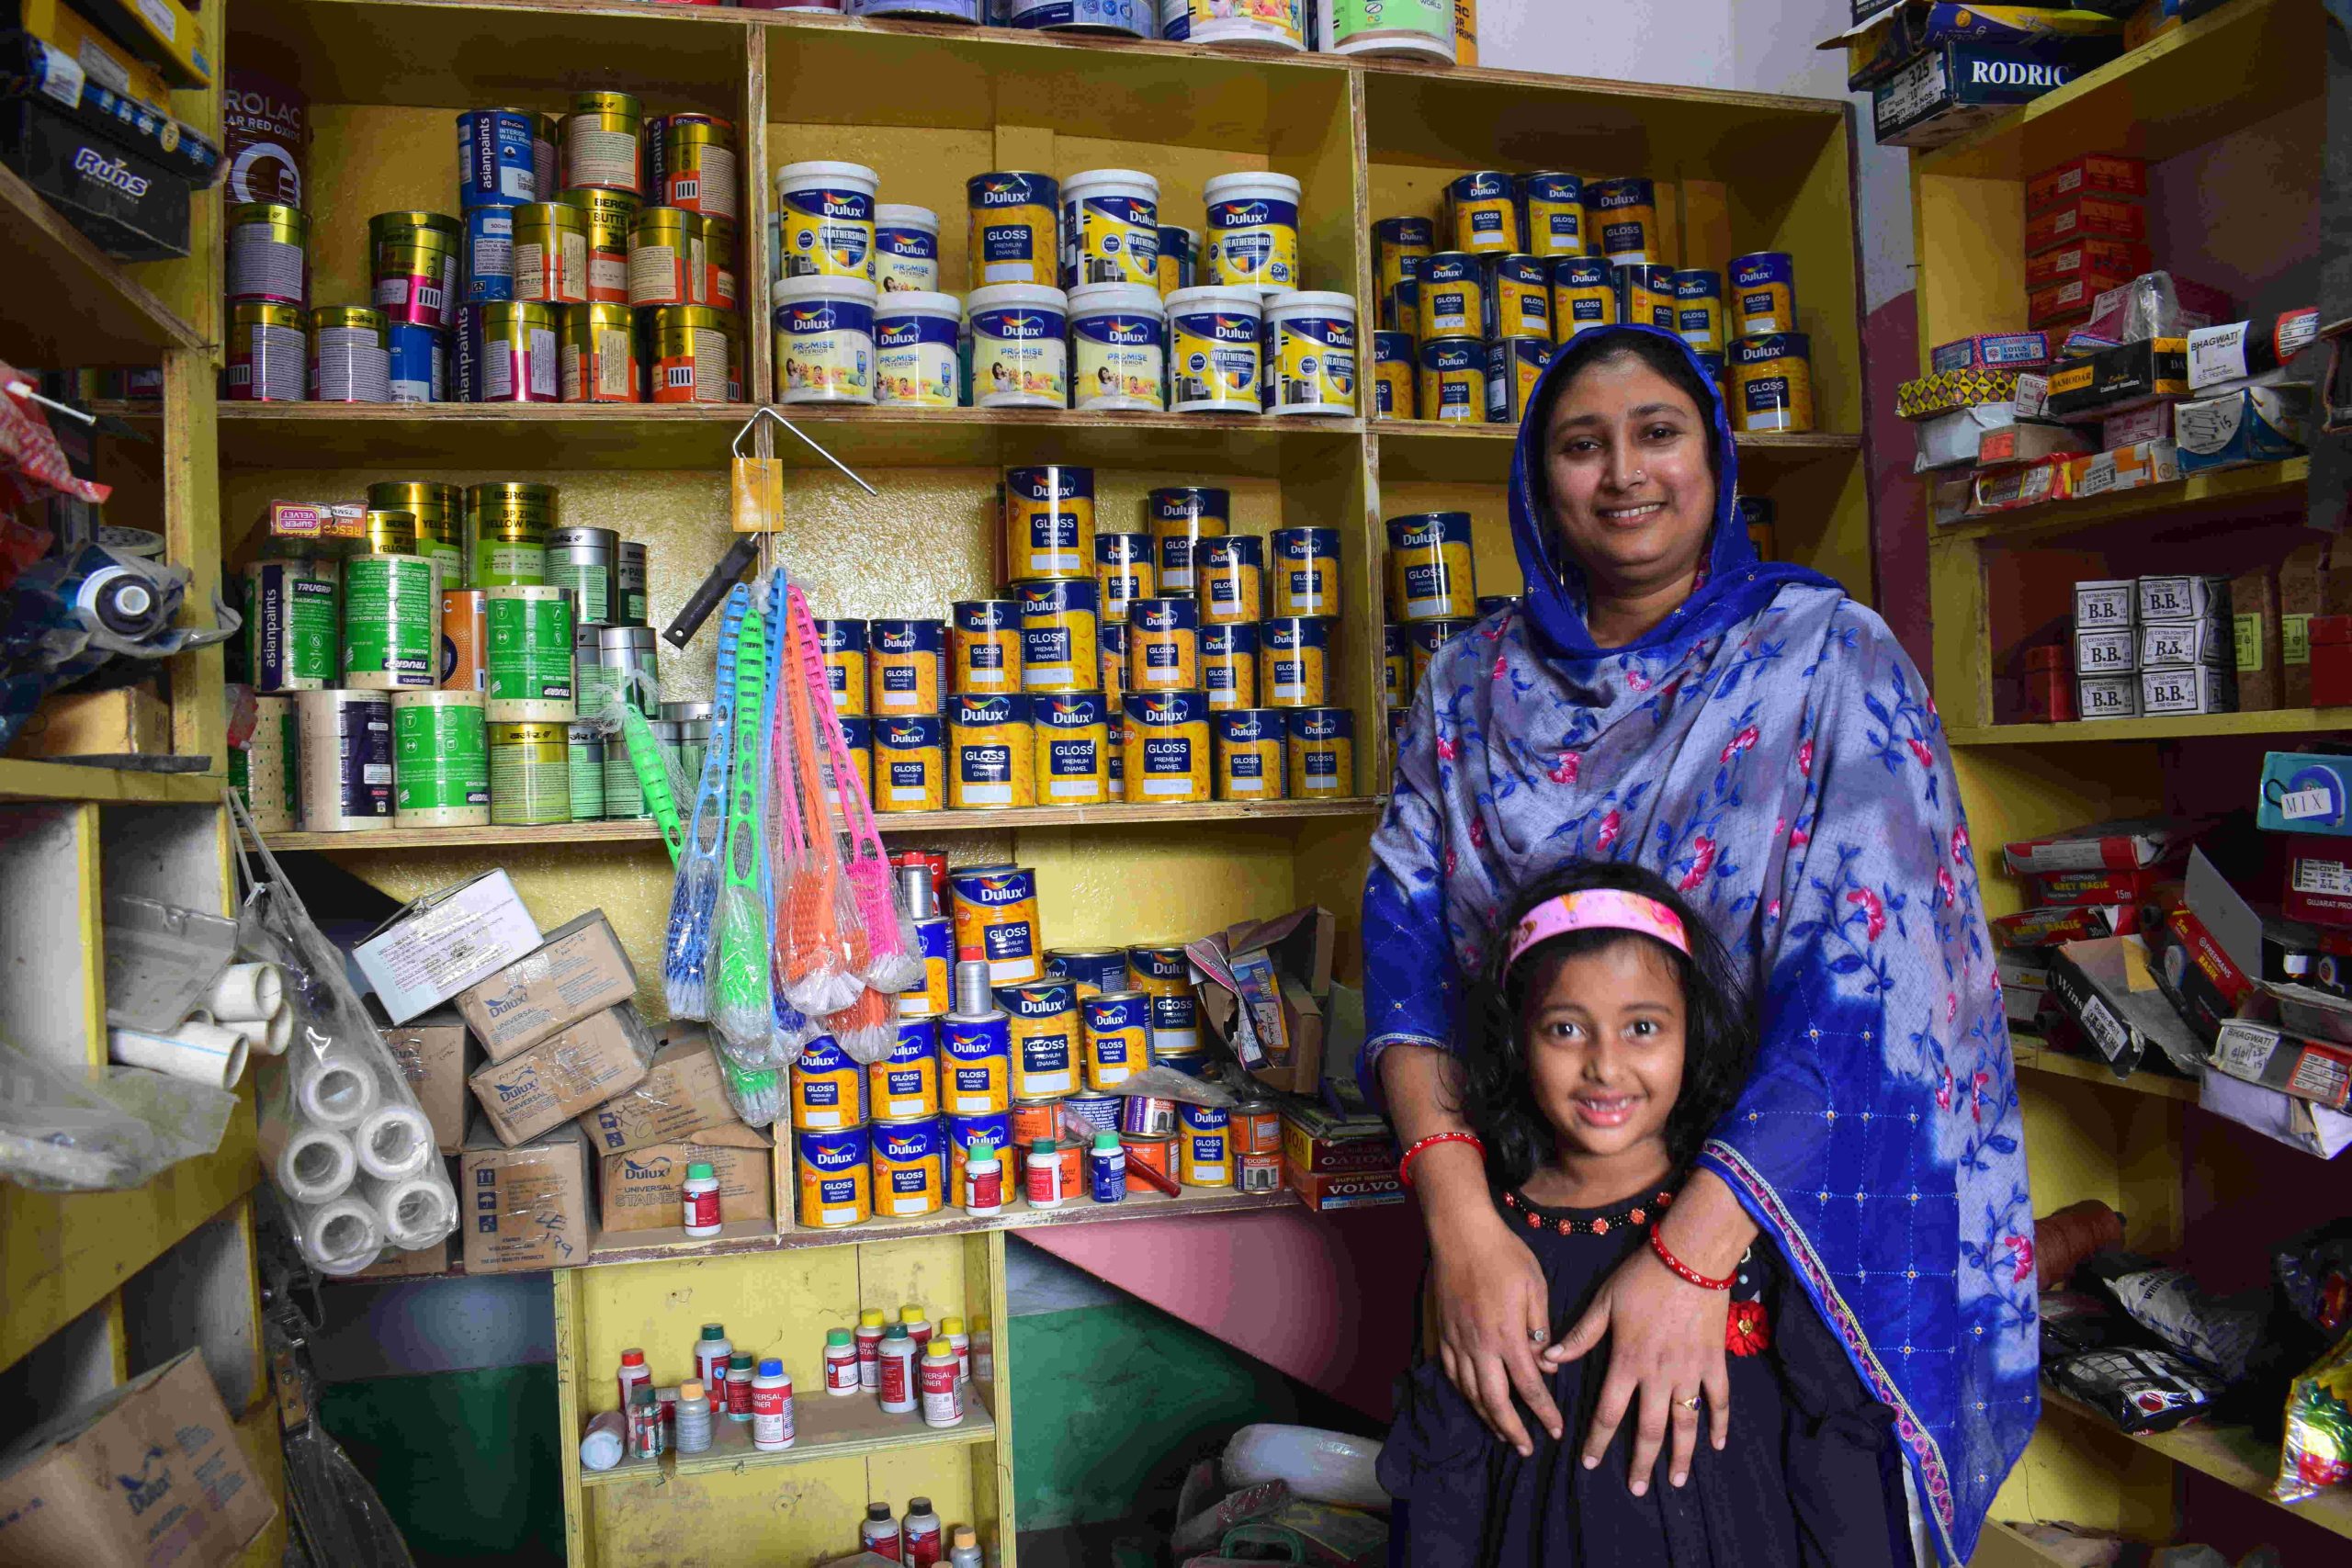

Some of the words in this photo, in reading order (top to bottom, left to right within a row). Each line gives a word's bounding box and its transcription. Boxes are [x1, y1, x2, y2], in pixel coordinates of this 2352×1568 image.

[224, 89, 300, 129] ROLAC
[248, 118, 272, 130] RED
[479, 118, 496, 188] asianpaints
[984, 191, 1027, 204] Dulux
[1471, 187, 1498, 197] Dulux
[1549, 190, 1575, 198] Dulux
[823, 202, 861, 217] Dulux
[1226, 213, 1263, 224] Dulux
[987, 231, 1027, 240] GLOSS
[1223, 236, 1274, 247] WEATHERSHIELD
[894, 243, 926, 255] Dulux
[893, 264, 929, 274] PROMISE
[1273, 265, 1283, 274] 2X
[1437, 296, 1461, 304] GLOSS
[795, 319, 830, 330] Dulux
[1003, 325, 1039, 336] Dulux
[1216, 326, 1251, 338] Dulux
[881, 333, 916, 344] Dulux
[1109, 332, 1145, 342] Dulux
[2191, 333, 2238, 351] BHAGWATI
[793, 341, 835, 350] PROMISE
[1001, 347, 1043, 355] PROMISE
[459, 307, 474, 402] sianpaints
[879, 355, 920, 364] PROMISE
[1107, 353, 1148, 362] PROMISE
[2220, 419, 2232, 429] 15
[1166, 540, 1193, 549] GLOS
[298, 583, 331, 593] TRUGRIP
[1026, 600, 1062, 613] Dulux
[2151, 593, 2179, 609] B.B.
[2089, 604, 2117, 618] B.B.
[265, 589, 282, 668] asianpaints
[884, 637, 912, 648] Dulux
[1028, 633, 1066, 644] GLOSS
[1148, 646, 1175, 654] GLOSS
[2092, 647, 2121, 662] B.B.
[544, 688, 570, 696] TRUGRIP
[2154, 686, 2185, 702] B.B.
[2092, 692, 2121, 706] B.B.
[961, 709, 1005, 721] Dulux
[1053, 711, 1090, 724] Dulux
[1146, 709, 1185, 722] Dulux
[891, 733, 920, 743] Dulux
[1055, 746, 1093, 756] GLOSS
[1148, 743, 1187, 753] GLOSS
[894, 764, 922, 773] GLOSS
[981, 887, 1023, 901] Dulux
[2115, 889, 2132, 899] 15m
[2307, 899, 2335, 908] GUJARAT
[1021, 999, 1063, 1013] Dulux
[496, 1007, 537, 1031] UNIVERSAL
[2227, 1029, 2272, 1045] BHAGWATI
[953, 1042, 987, 1053] Dulux
[1098, 1041, 1124, 1050] GLOSS
[1036, 1058, 1060, 1066] ENAMEL
[891, 1073, 919, 1082] GLOSS
[958, 1071, 987, 1079] GLOSS
[807, 1084, 835, 1093] GLOSS
[506, 1092, 547, 1114] UNIVERSAL
[1194, 1112, 1223, 1122] Dulux
[1195, 1139, 1221, 1147] GLOSS
[888, 1143, 923, 1155] Dulux
[817, 1154, 853, 1165] Dulux
[626, 1169, 666, 1179] Dulux
[895, 1171, 923, 1180] GLOSS
[824, 1181, 853, 1190] GLOSS
[1328, 1181, 1398, 1194] VOLVO
[924, 1371, 951, 1380] VERSAL
